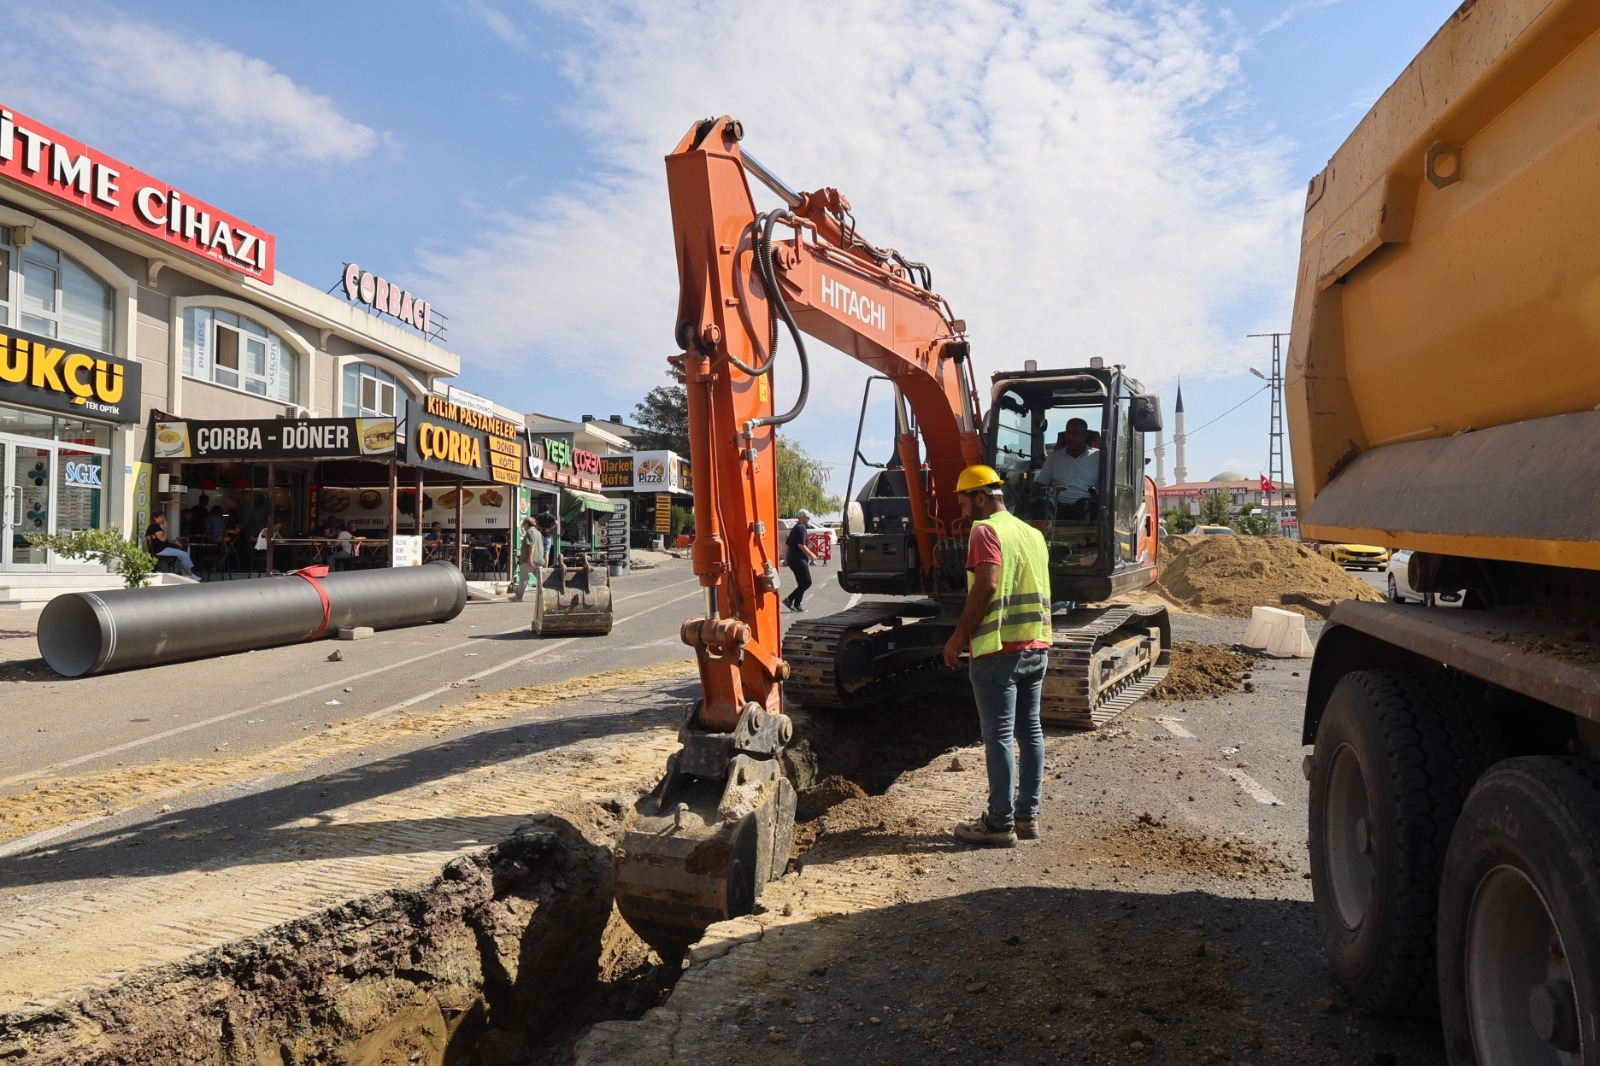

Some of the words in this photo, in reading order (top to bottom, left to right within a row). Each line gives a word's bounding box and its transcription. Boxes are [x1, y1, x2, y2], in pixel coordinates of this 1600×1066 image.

[0, 108, 120, 207] İTME
[137, 186, 266, 270] CİHAZI
[345, 263, 431, 332] ÇORBACI
[821, 274, 886, 332] HITACHI
[198, 321, 206, 369] PHILIPS
[0, 333, 124, 405] ÜKÇÜ
[86, 401, 99, 410] TEK
[99, 404, 120, 415] OPTİK
[427, 395, 458, 421] KİLİM
[197, 426, 262, 454] ÇORBA
[283, 421, 349, 449] DÖNER
[420, 422, 482, 468] ÇORBA
[545, 437, 572, 470] YEŞİL
[65, 461, 101, 485] SGK
[601, 459, 633, 472] Market
[601, 473, 629, 485] Köfte
[639, 472, 662, 484] Pizza
